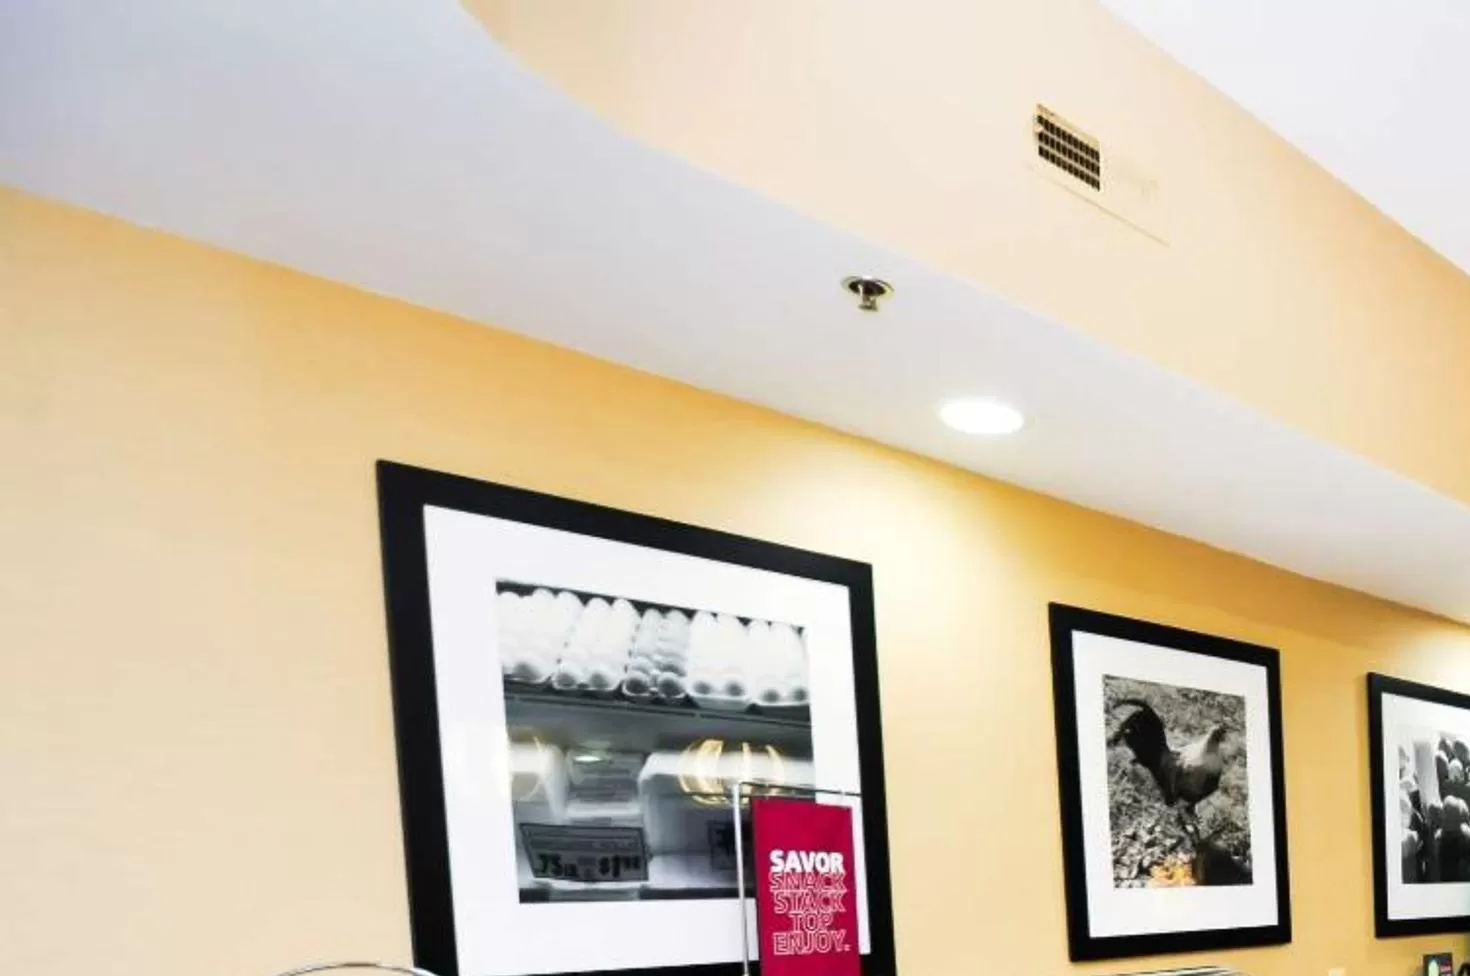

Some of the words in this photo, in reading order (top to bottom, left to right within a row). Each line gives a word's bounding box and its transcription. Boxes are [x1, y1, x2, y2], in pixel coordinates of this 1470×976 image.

[769, 849, 846, 873] SAVOR
[768, 871, 847, 892] SNACK
[773, 890, 846, 914] STACK
[789, 912, 834, 932] TOP
[773, 930, 851, 955] ENJOY.
